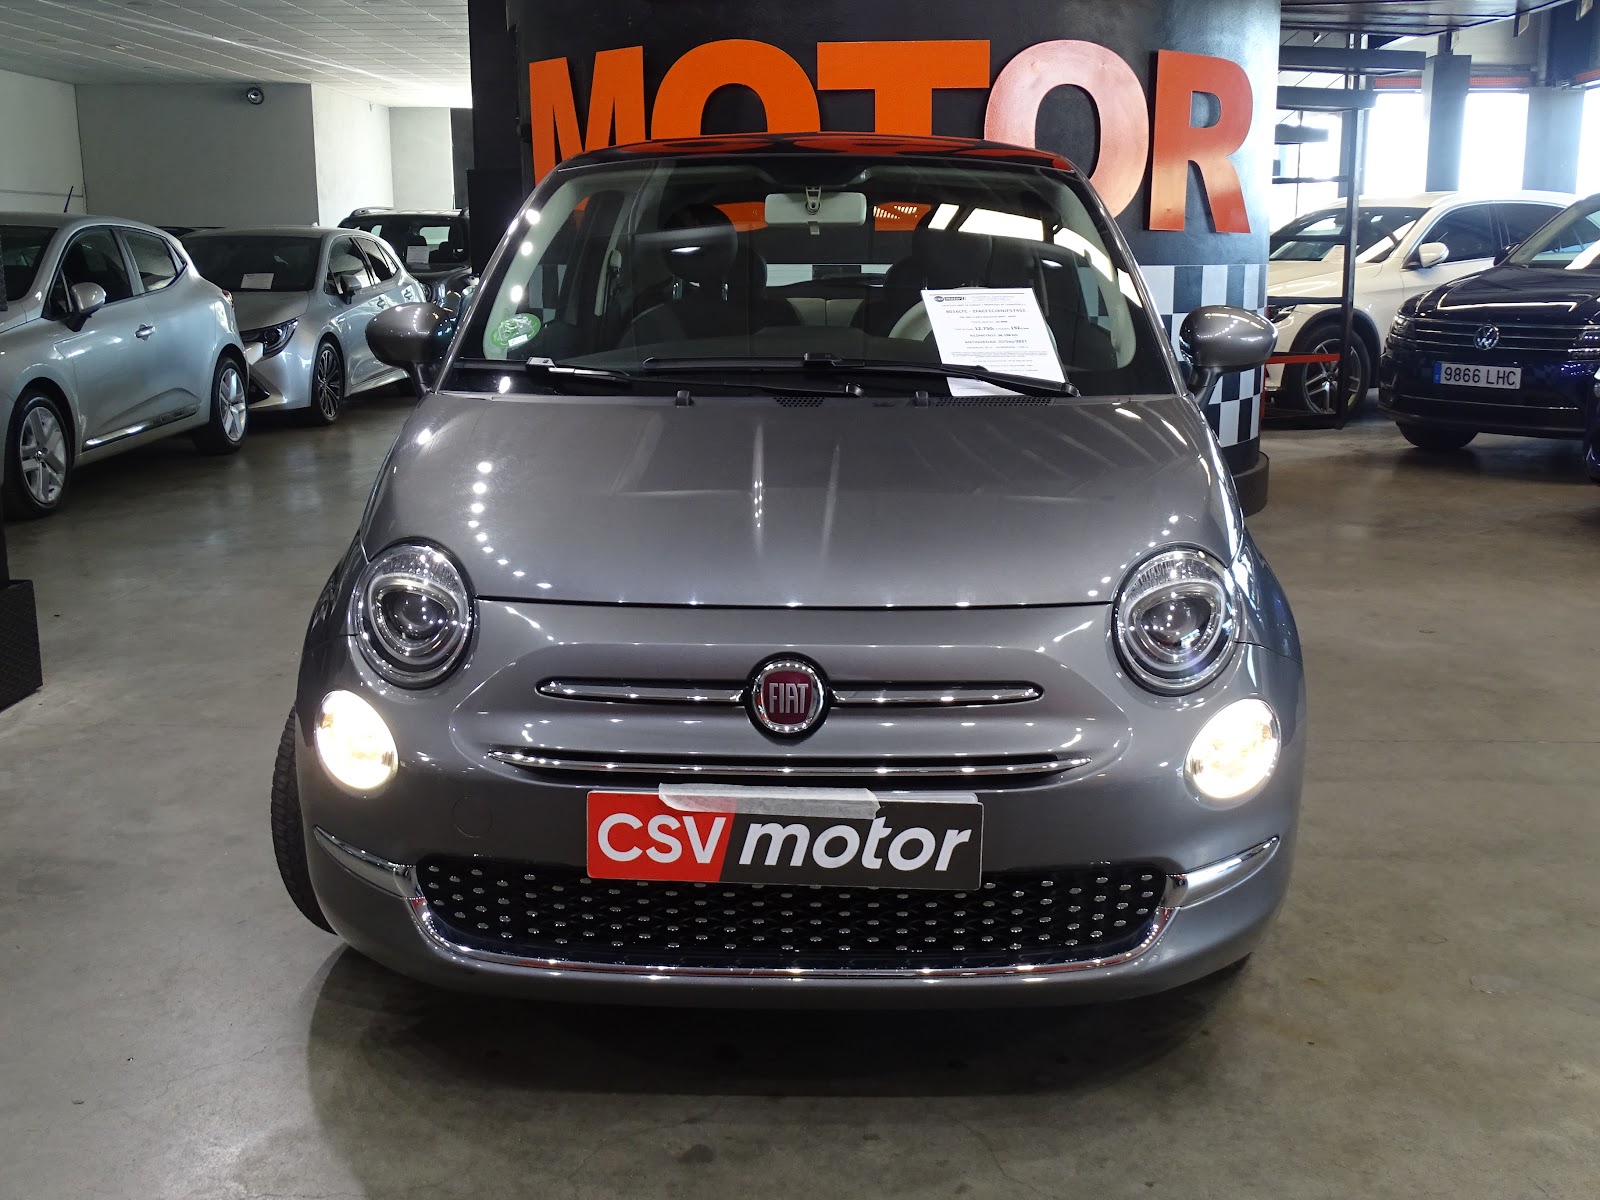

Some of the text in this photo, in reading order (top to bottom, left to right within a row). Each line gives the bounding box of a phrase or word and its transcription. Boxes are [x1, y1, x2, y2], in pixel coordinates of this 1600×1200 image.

[1444, 366, 1481, 383] 9866
[1486, 369, 1516, 386] LHC
[768, 682, 809, 714] FIAT
[597, 812, 972, 871] CSV motor
